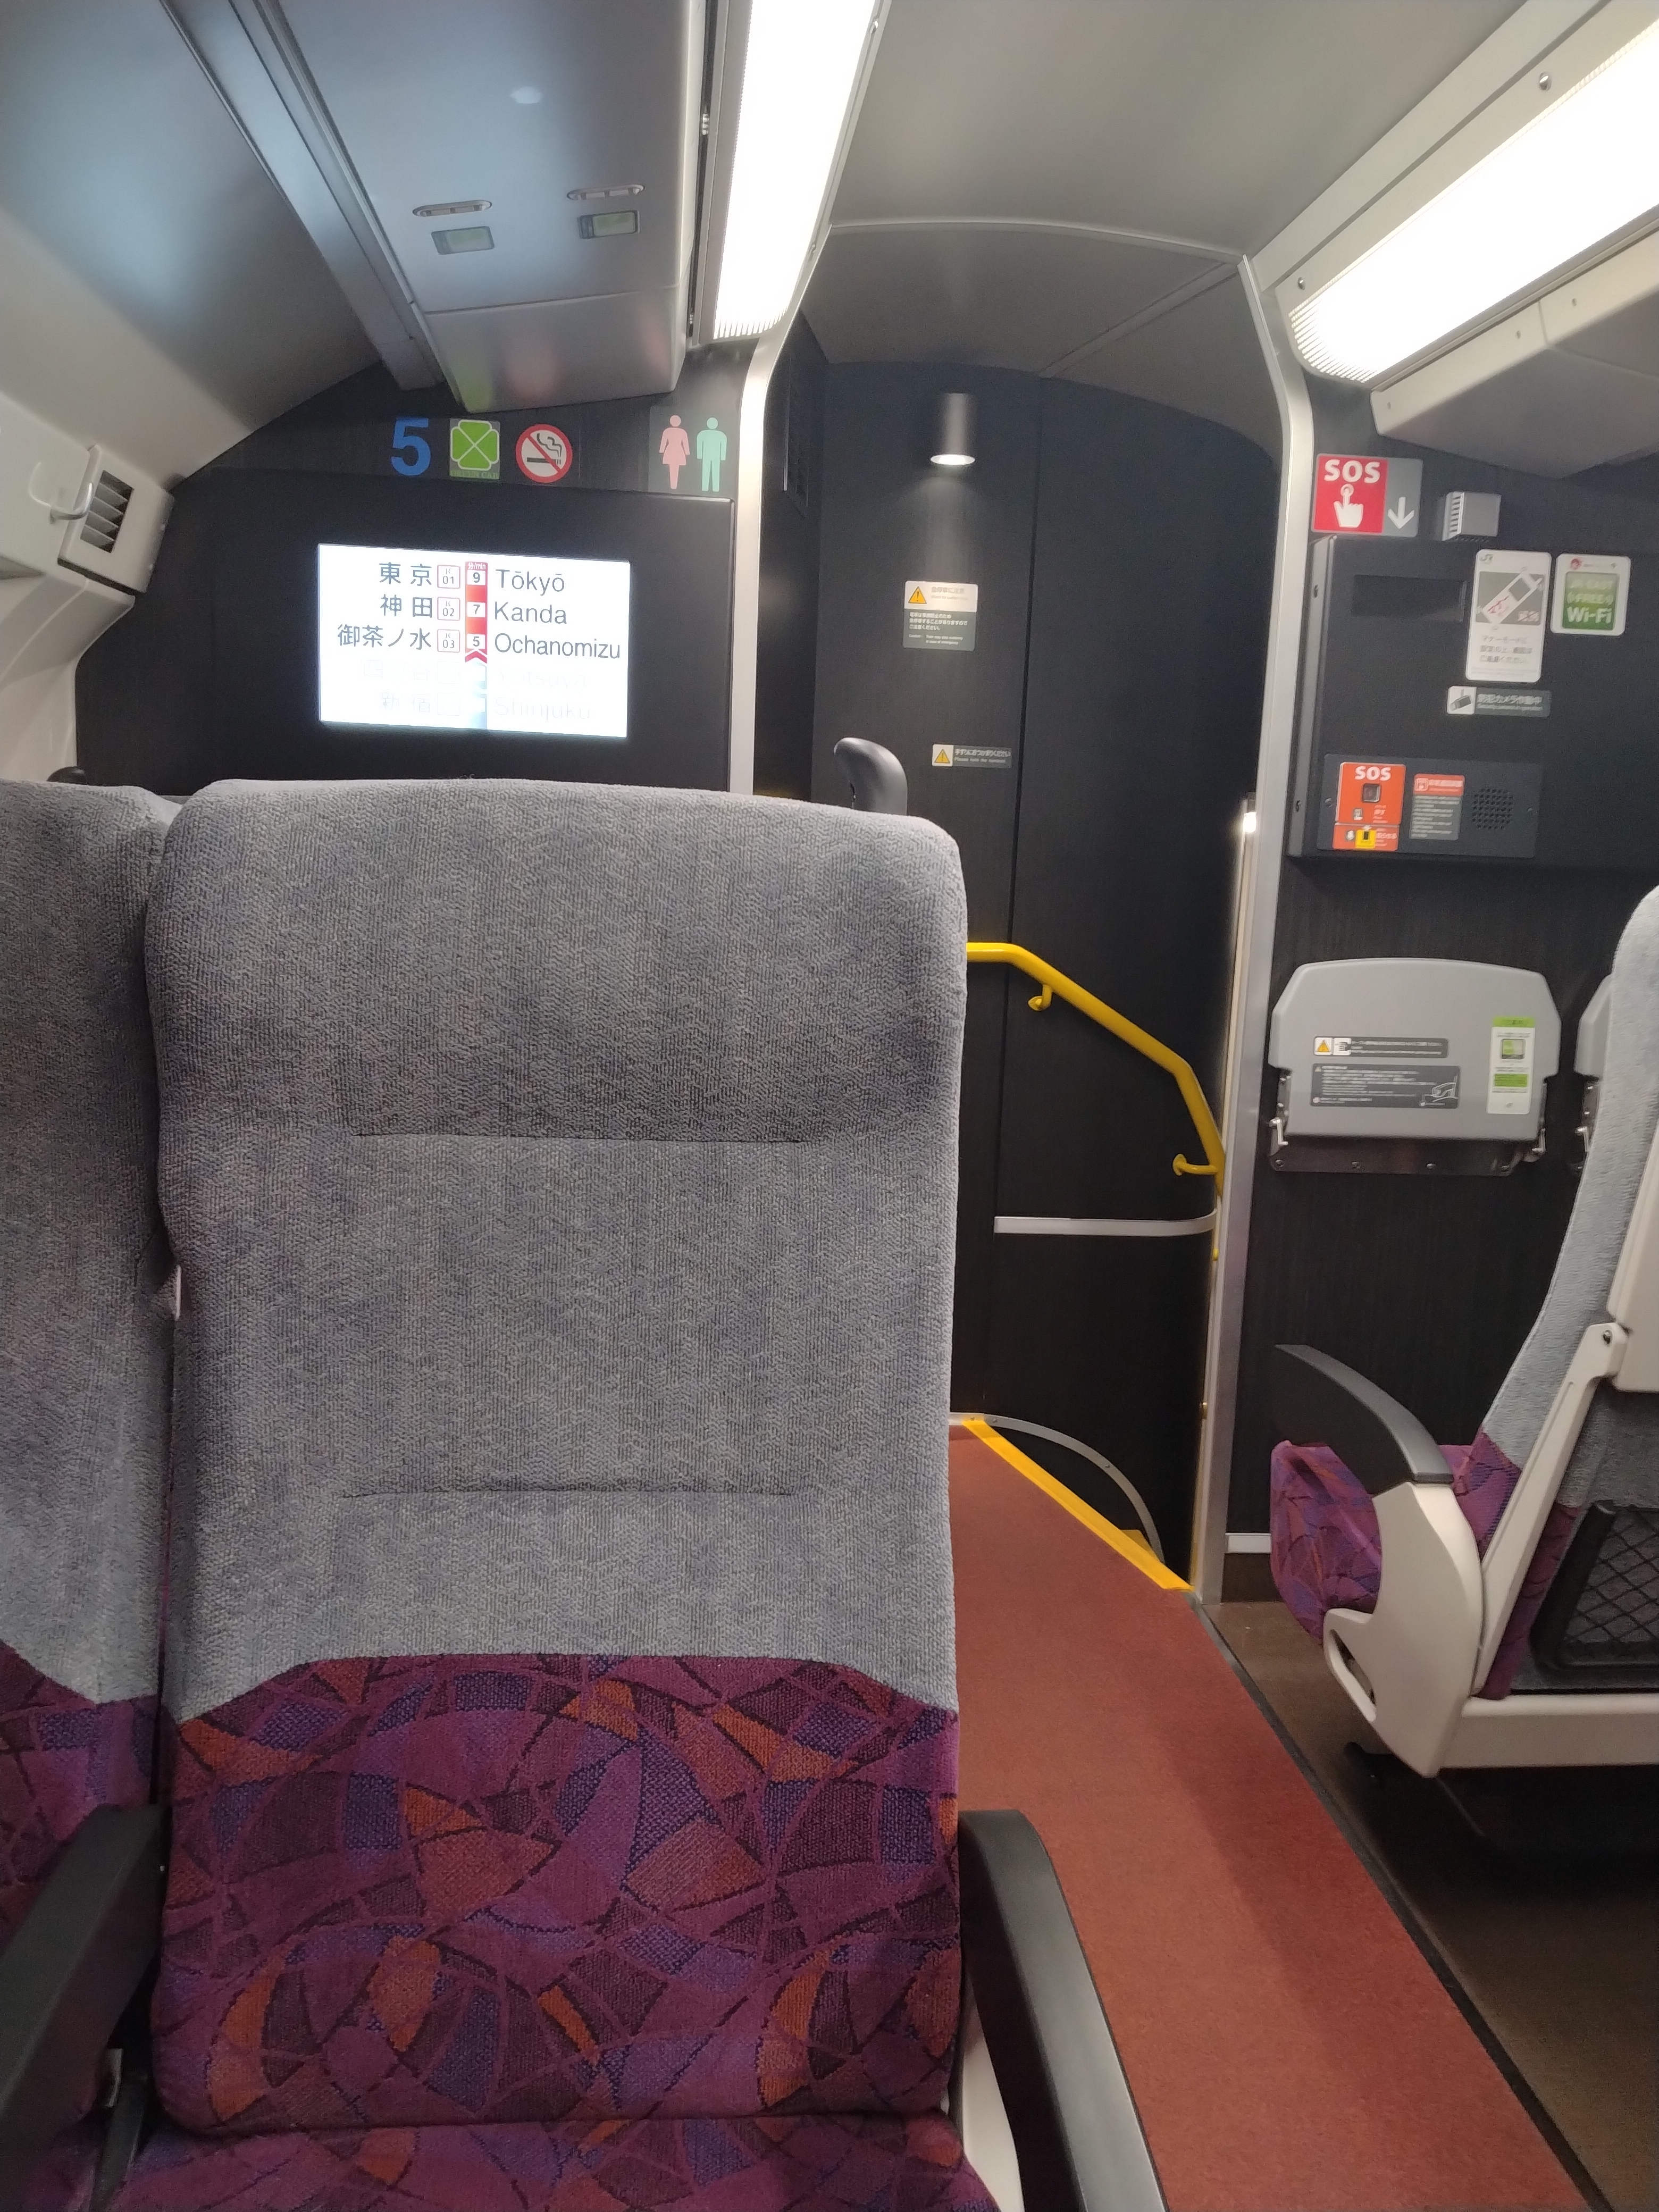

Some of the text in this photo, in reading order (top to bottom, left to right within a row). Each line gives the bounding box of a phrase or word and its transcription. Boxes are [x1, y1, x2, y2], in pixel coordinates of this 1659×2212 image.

[391, 417, 431, 476] 5
[1323, 459, 1381, 483] SOS
[379, 562, 433, 586] 東京
[442, 575, 455, 585] 01
[472, 572, 481, 583] 9
[495, 569, 565, 596] Tōkyō
[380, 594, 433, 617] 神田
[442, 607, 455, 617] 02
[472, 605, 481, 615] 7
[495, 601, 568, 625] Kanda
[1566, 606, 1613, 624] Wi-Fi
[337, 624, 432, 650] 御茶ノ水
[442, 639, 455, 649] 03
[472, 636, 481, 647] 5
[495, 633, 621, 659] Ochanomizu
[1354, 766, 1392, 781] SOS
